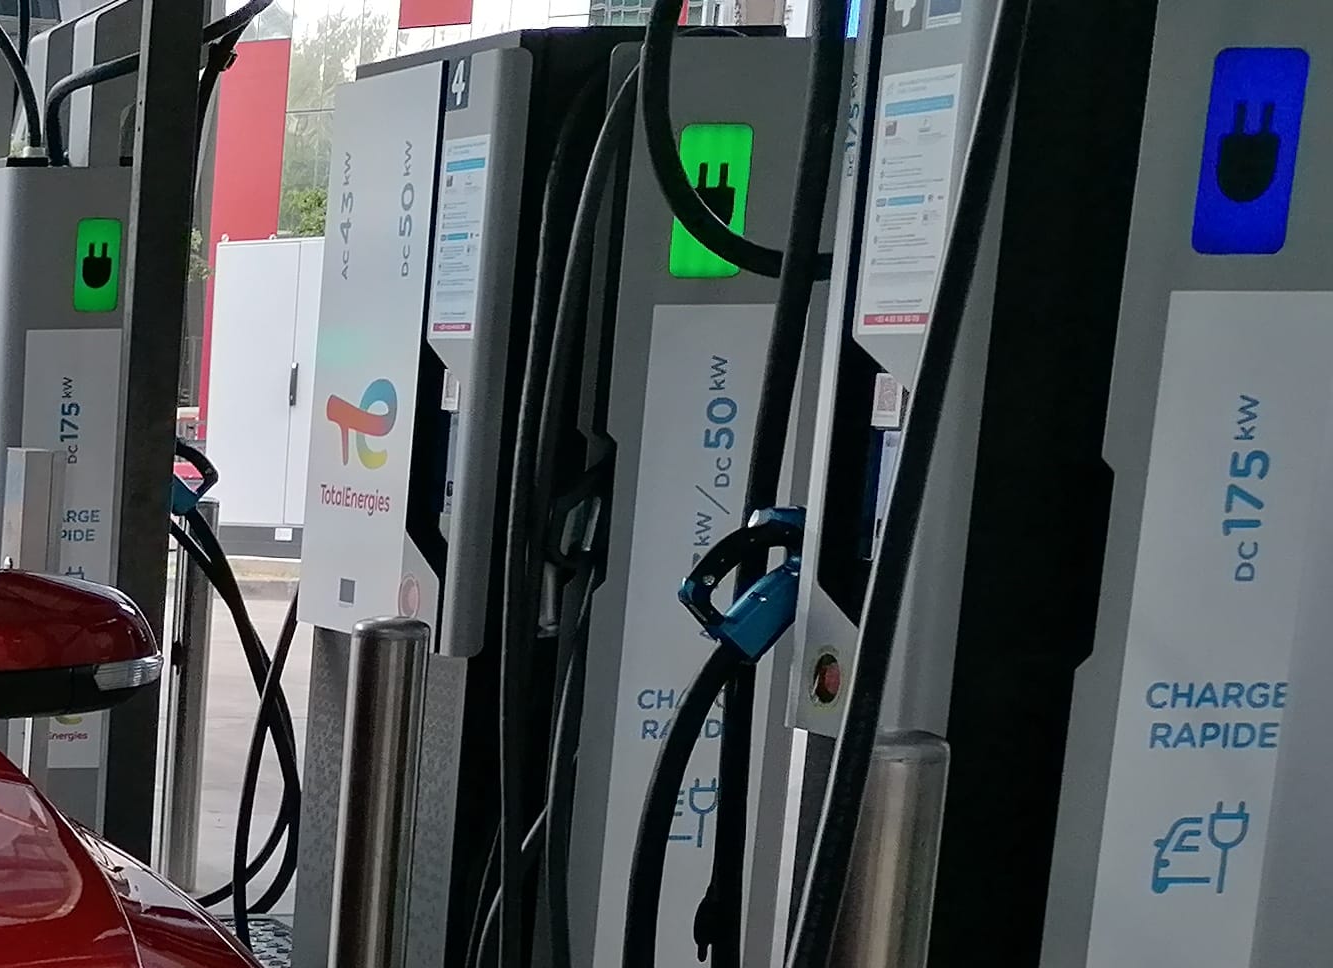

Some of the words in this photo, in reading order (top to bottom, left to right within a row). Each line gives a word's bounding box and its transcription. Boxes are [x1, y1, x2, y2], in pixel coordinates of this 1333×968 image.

[451, 59, 465, 107] 4
[343, 152, 351, 186] kW
[403, 140, 413, 176] kW
[340, 191, 353, 245] 43
[399, 182, 414, 238] 50
[341, 250, 350, 280] AC
[401, 245, 410, 277] DC
[62, 376, 73, 399] kW
[709, 355, 728, 391] kW
[60, 402, 80, 443] 175
[703, 397, 738, 450] 50
[1234, 394, 1260, 441] kW
[67, 444, 78, 464] DC
[714, 457, 732, 488] DC
[321, 484, 390, 516] TotalEnergies
[1222, 450, 1270, 536] 175
[63, 509, 101, 523] RGE
[1235, 541, 1259, 582] DC
[1146, 682, 1289, 709] CHARGE
[1149, 722, 1280, 749] RAPIDE
